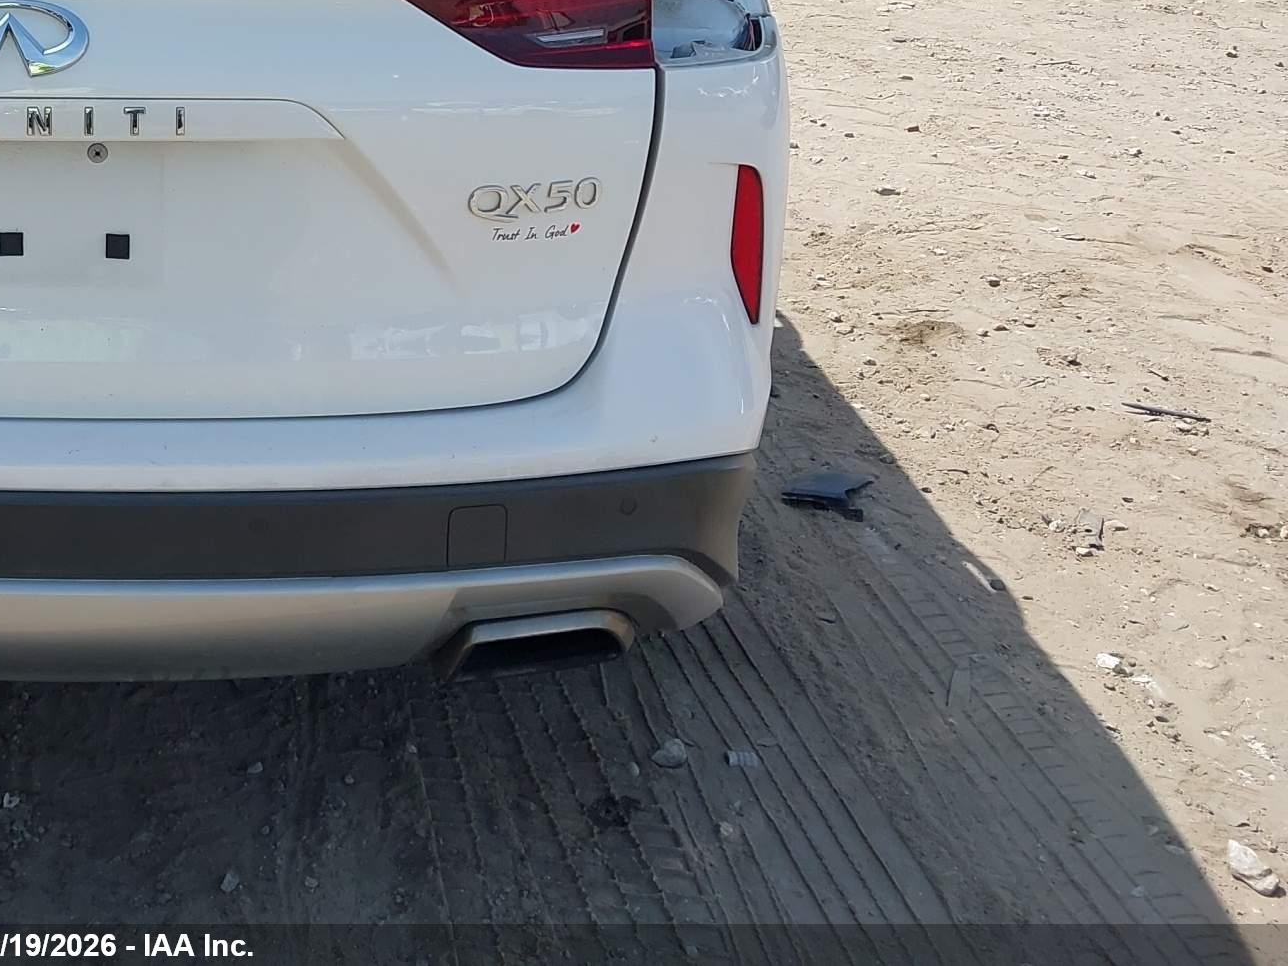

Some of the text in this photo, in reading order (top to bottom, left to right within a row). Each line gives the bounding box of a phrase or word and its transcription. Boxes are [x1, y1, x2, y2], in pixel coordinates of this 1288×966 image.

[468, 177, 600, 223] QX50
[492, 224, 569, 241] Trust In God
